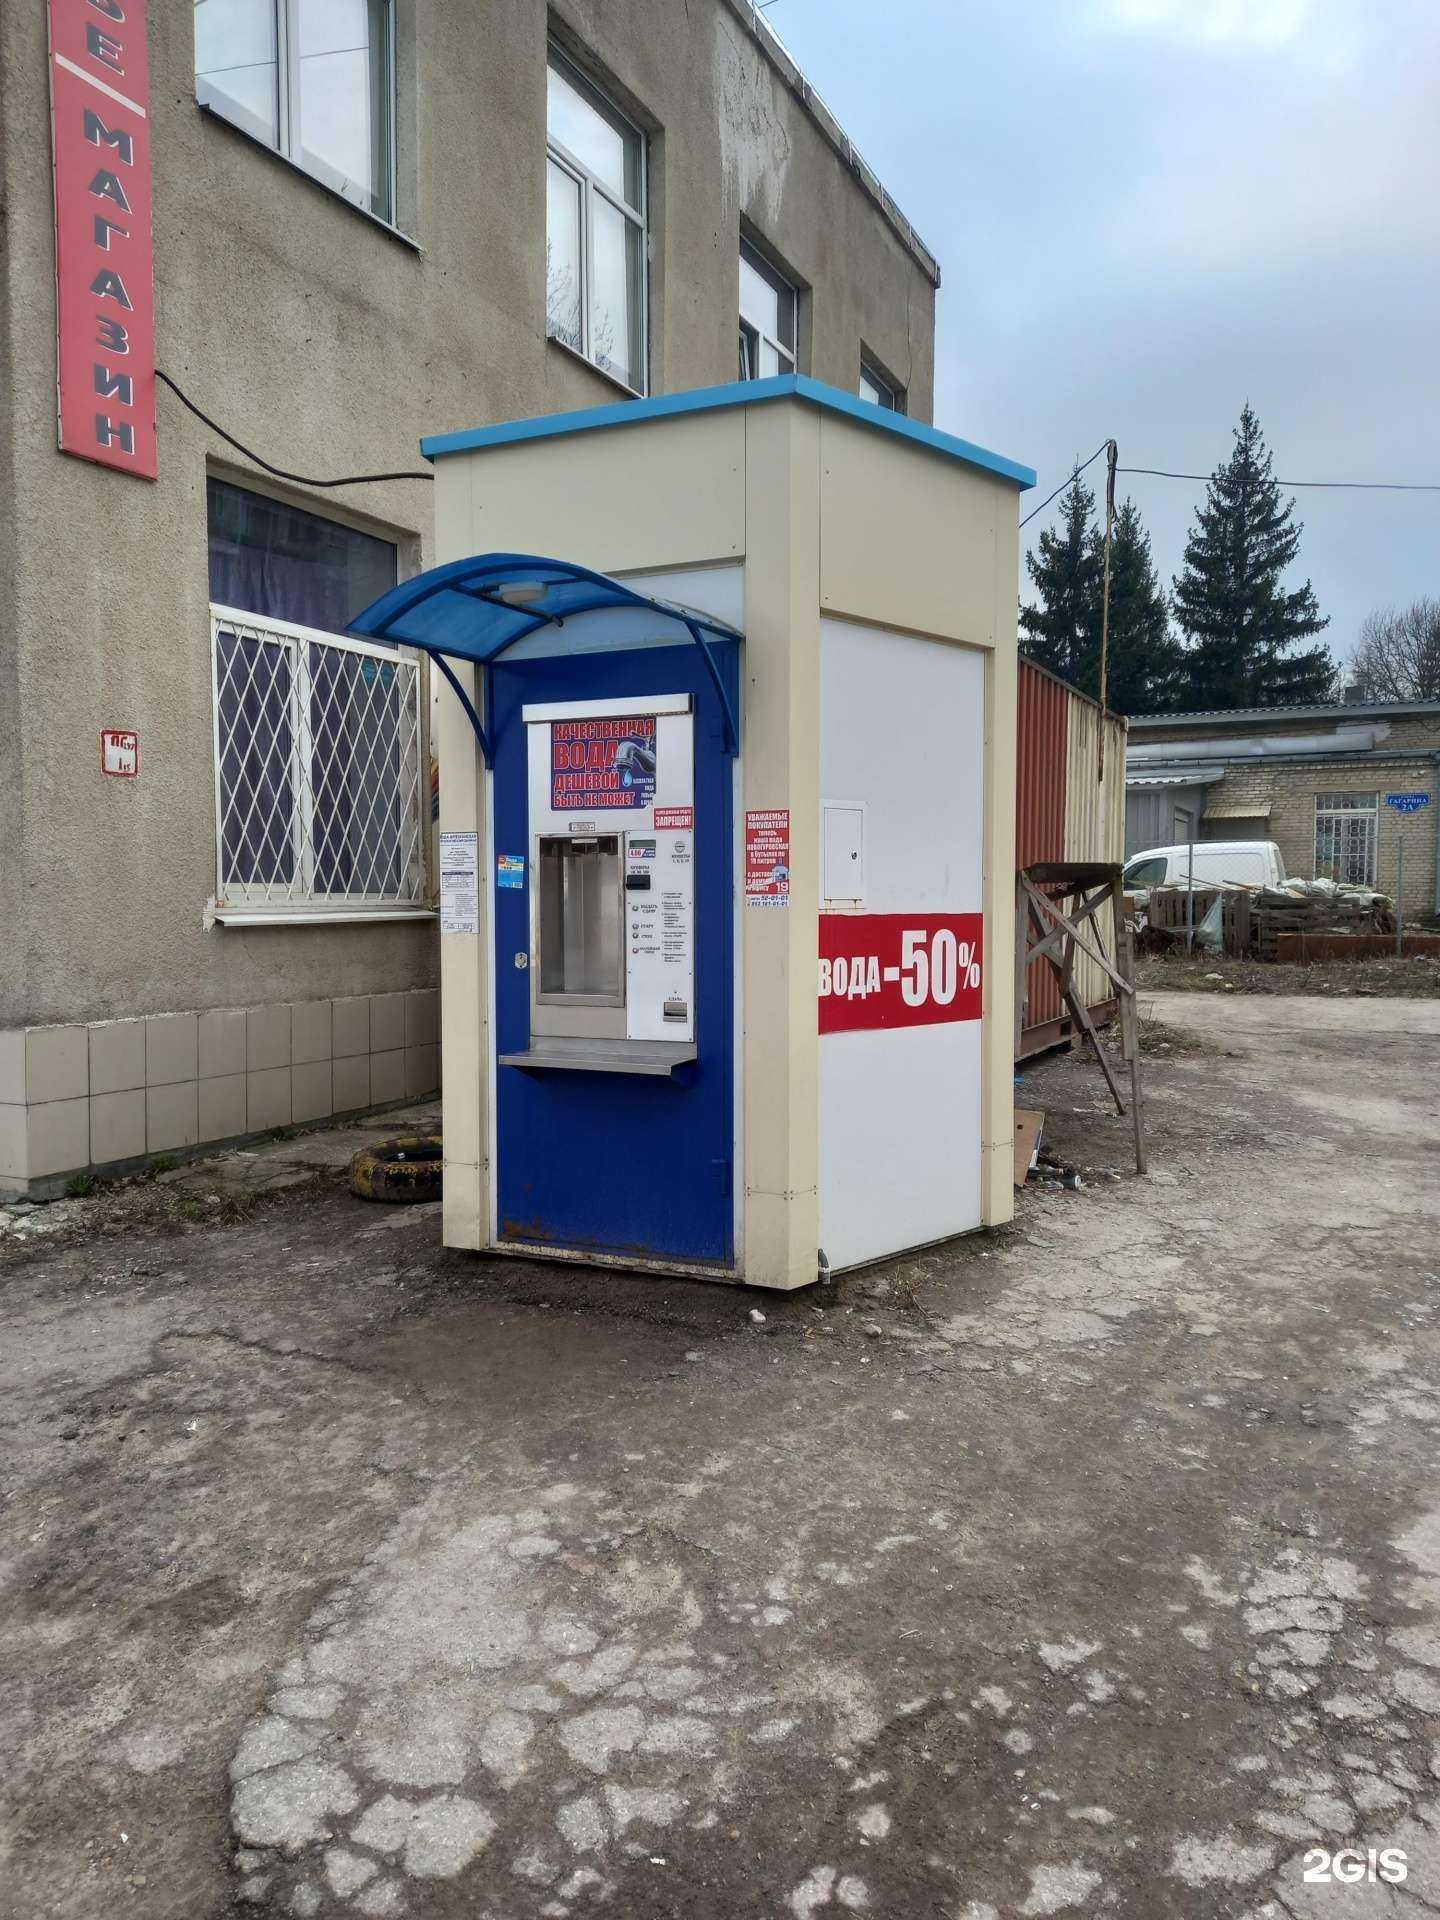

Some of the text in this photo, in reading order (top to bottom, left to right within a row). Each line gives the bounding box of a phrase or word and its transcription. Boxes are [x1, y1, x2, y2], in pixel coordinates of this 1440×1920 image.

[83, 108, 135, 456] МАГАЗИН
[554, 719, 655, 740] КАЧЕСТВЕННАЯ
[554, 740, 619, 772] ВОДА
[555, 771, 619, 793] ДЕШЕВОЙ
[554, 793, 583, 807] БЫТЬ
[584, 793, 599, 806] НЕ
[599, 792, 636, 806] МОЖЕТ
[655, 815, 692, 828] ЗАПРЕЩЕН!
[748, 812, 788, 821] УВАЖАЕМЫЕ
[776, 882, 789, 892] 19
[816, 928, 982, 1008] ВОДА -50%
